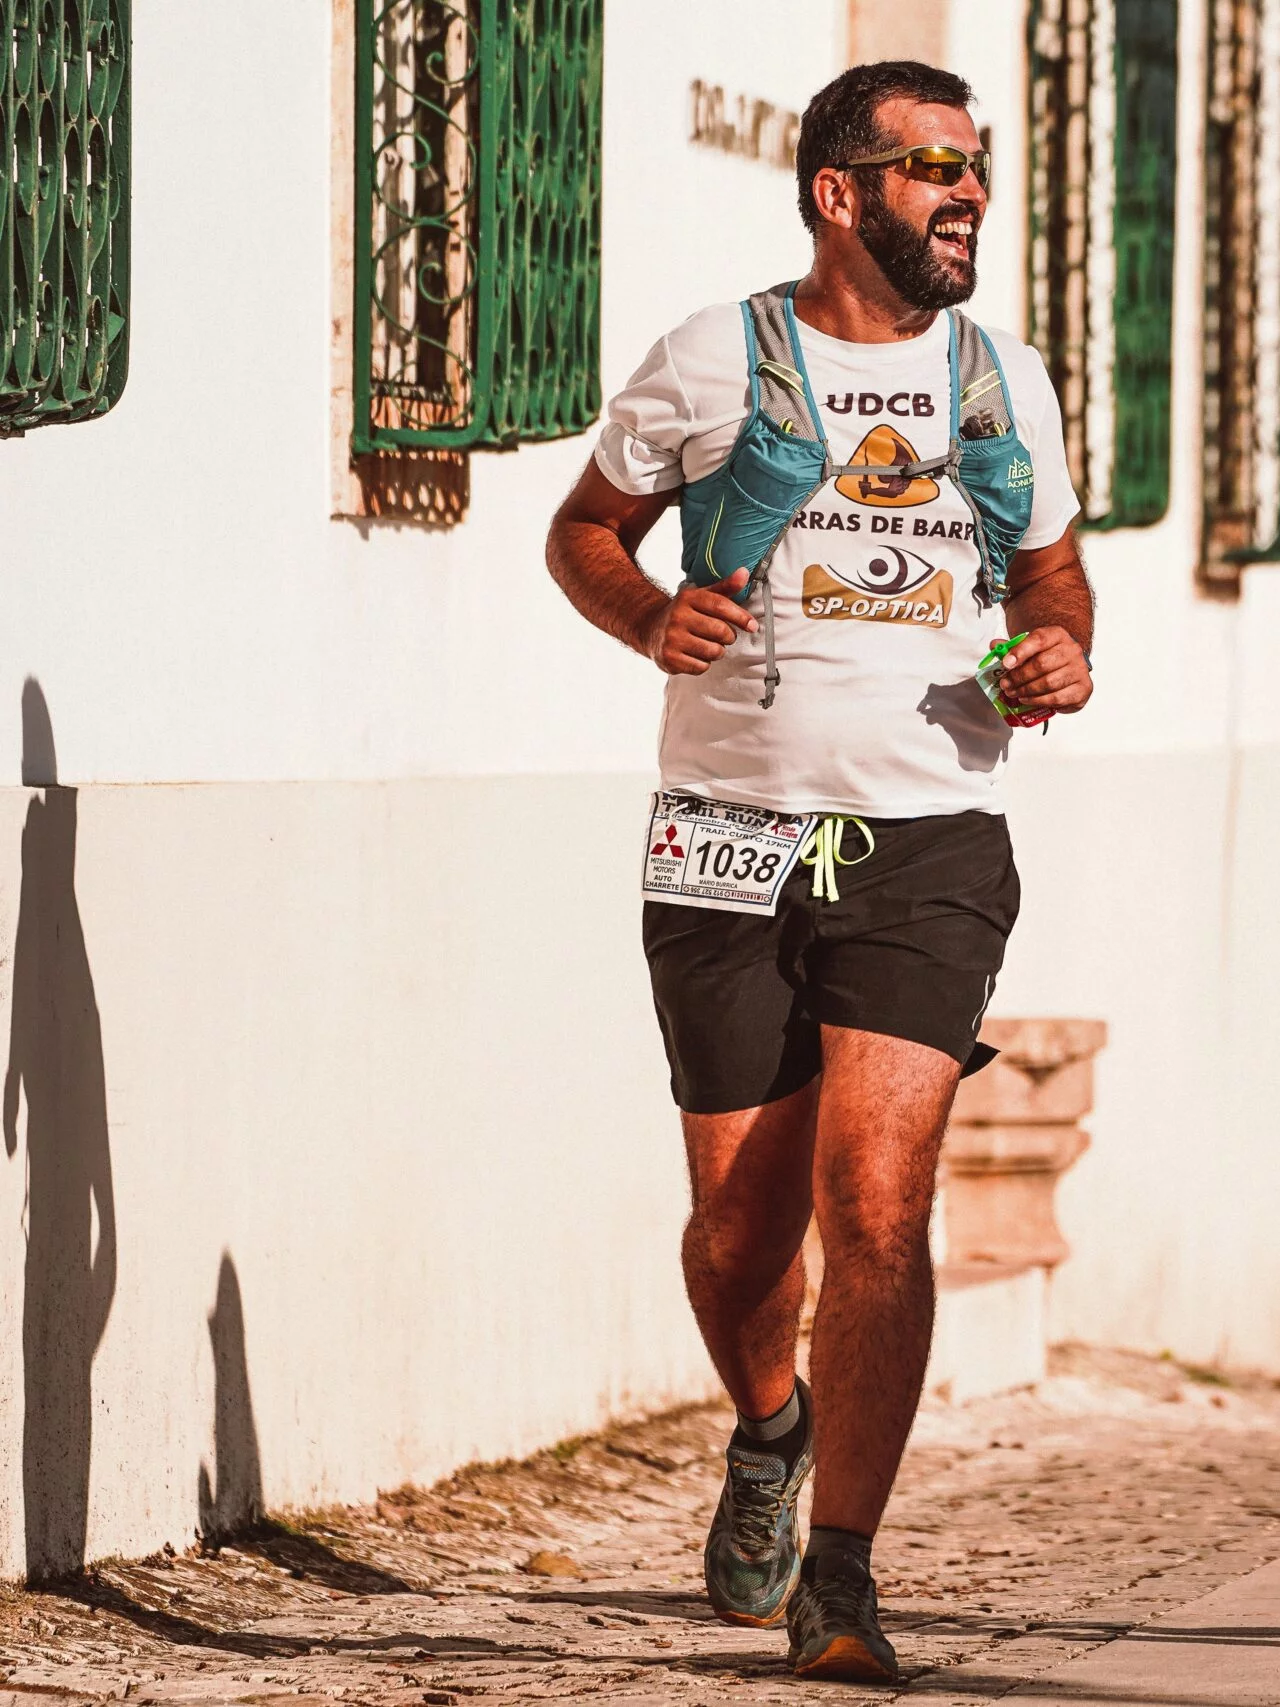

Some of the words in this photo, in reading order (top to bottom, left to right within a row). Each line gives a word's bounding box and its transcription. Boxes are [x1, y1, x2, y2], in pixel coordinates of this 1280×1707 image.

[826, 391, 935, 417] UDCB
[792, 510, 861, 532] RRAS
[871, 515, 904, 535] DE
[808, 596, 945, 625] SP-OPTICA
[685, 815, 727, 827] Setembro
[699, 826, 727, 836] TRAIL
[728, 831, 763, 843] CURTO
[765, 839, 792, 850] 17KM
[650, 857, 682, 868] MITSUBISHI
[653, 865, 676, 875] MOTORS
[696, 840, 781, 884] 1038
[645, 880, 680, 891] CHARRETE
[654, 874, 672, 883] AUTO
